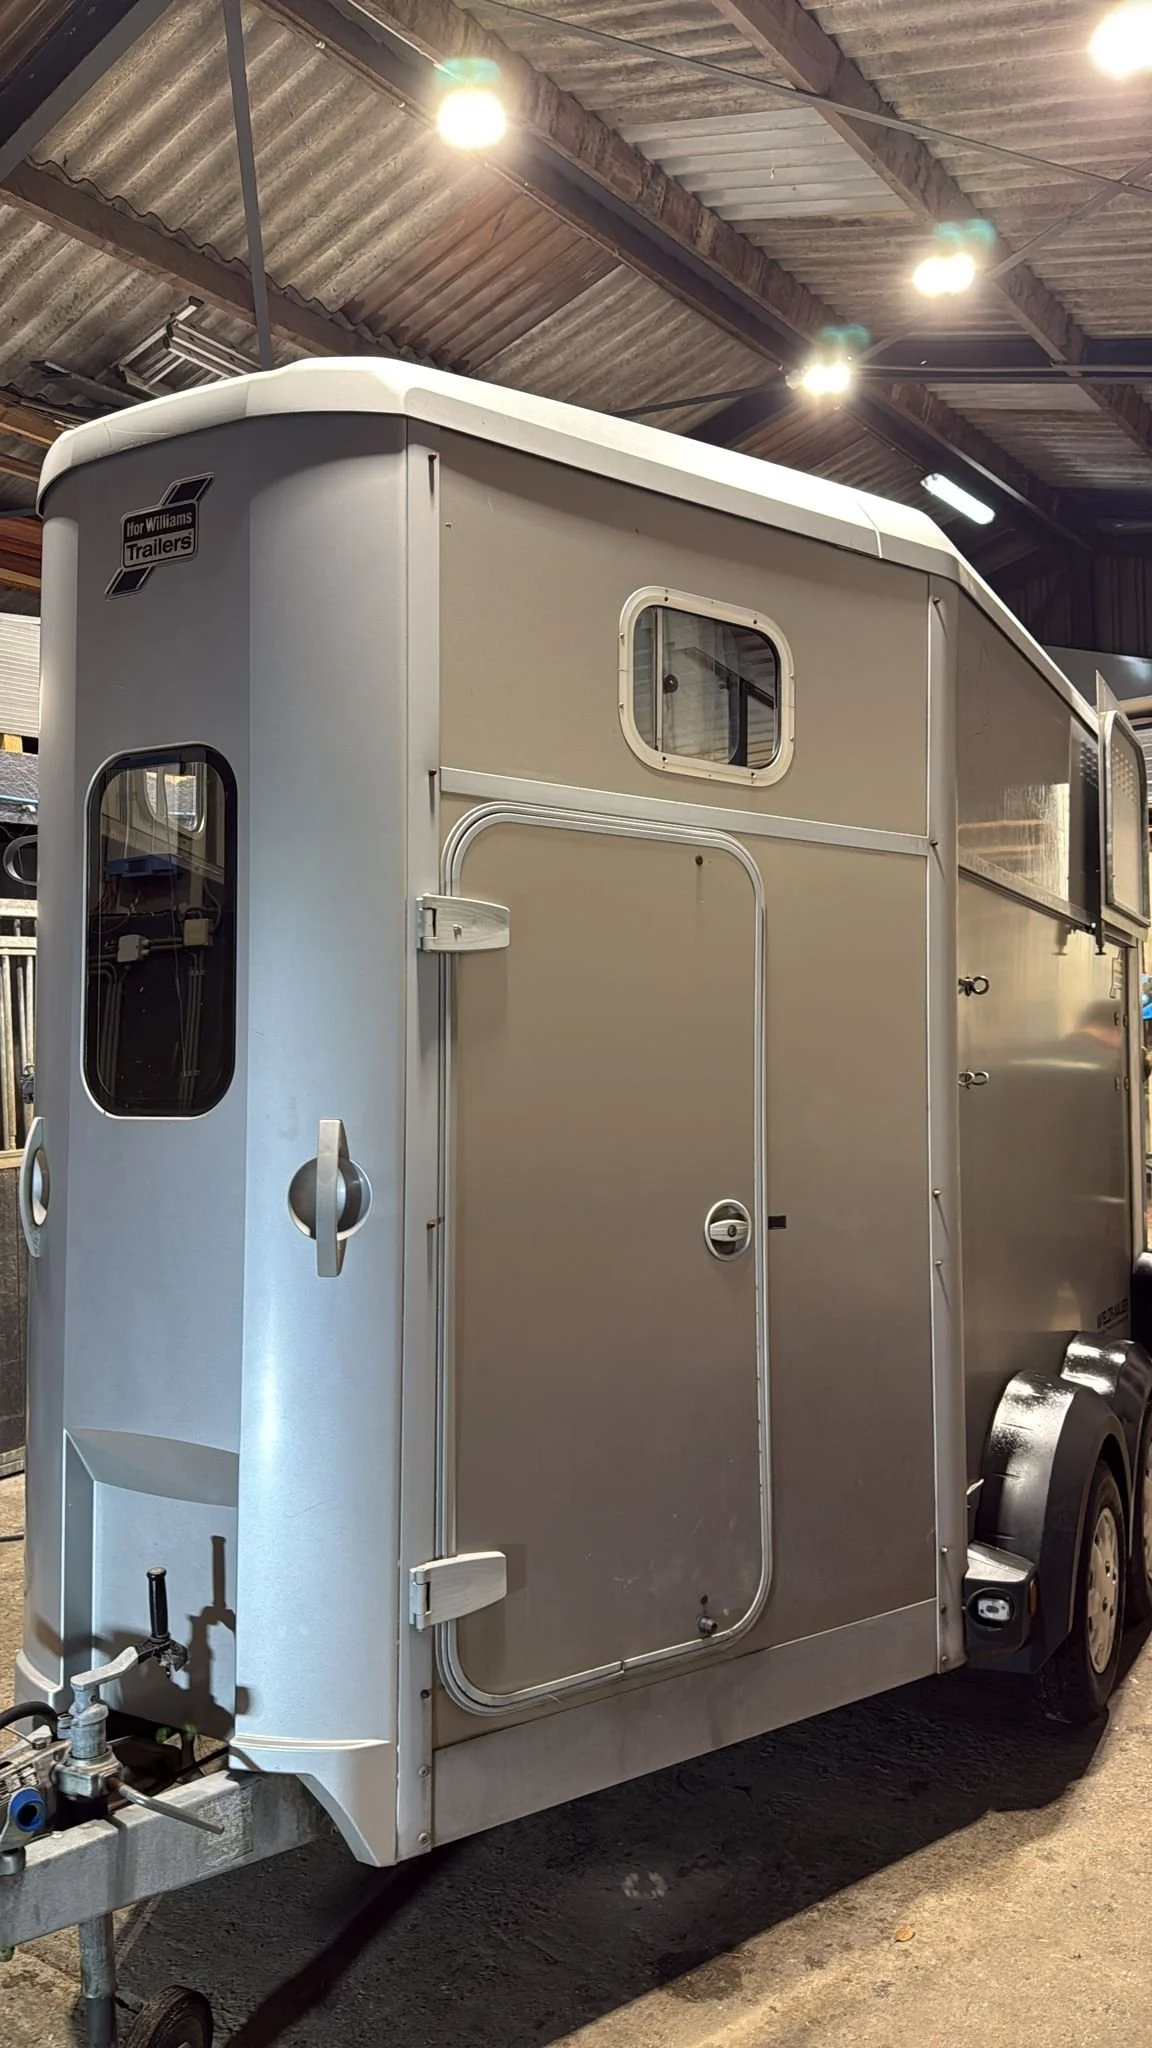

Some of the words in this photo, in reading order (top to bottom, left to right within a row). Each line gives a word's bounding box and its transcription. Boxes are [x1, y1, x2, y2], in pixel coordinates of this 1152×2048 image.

[126, 521, 145, 537] Ifor
[145, 511, 193, 533] Williams
[126, 535, 192, 561] Trailers
